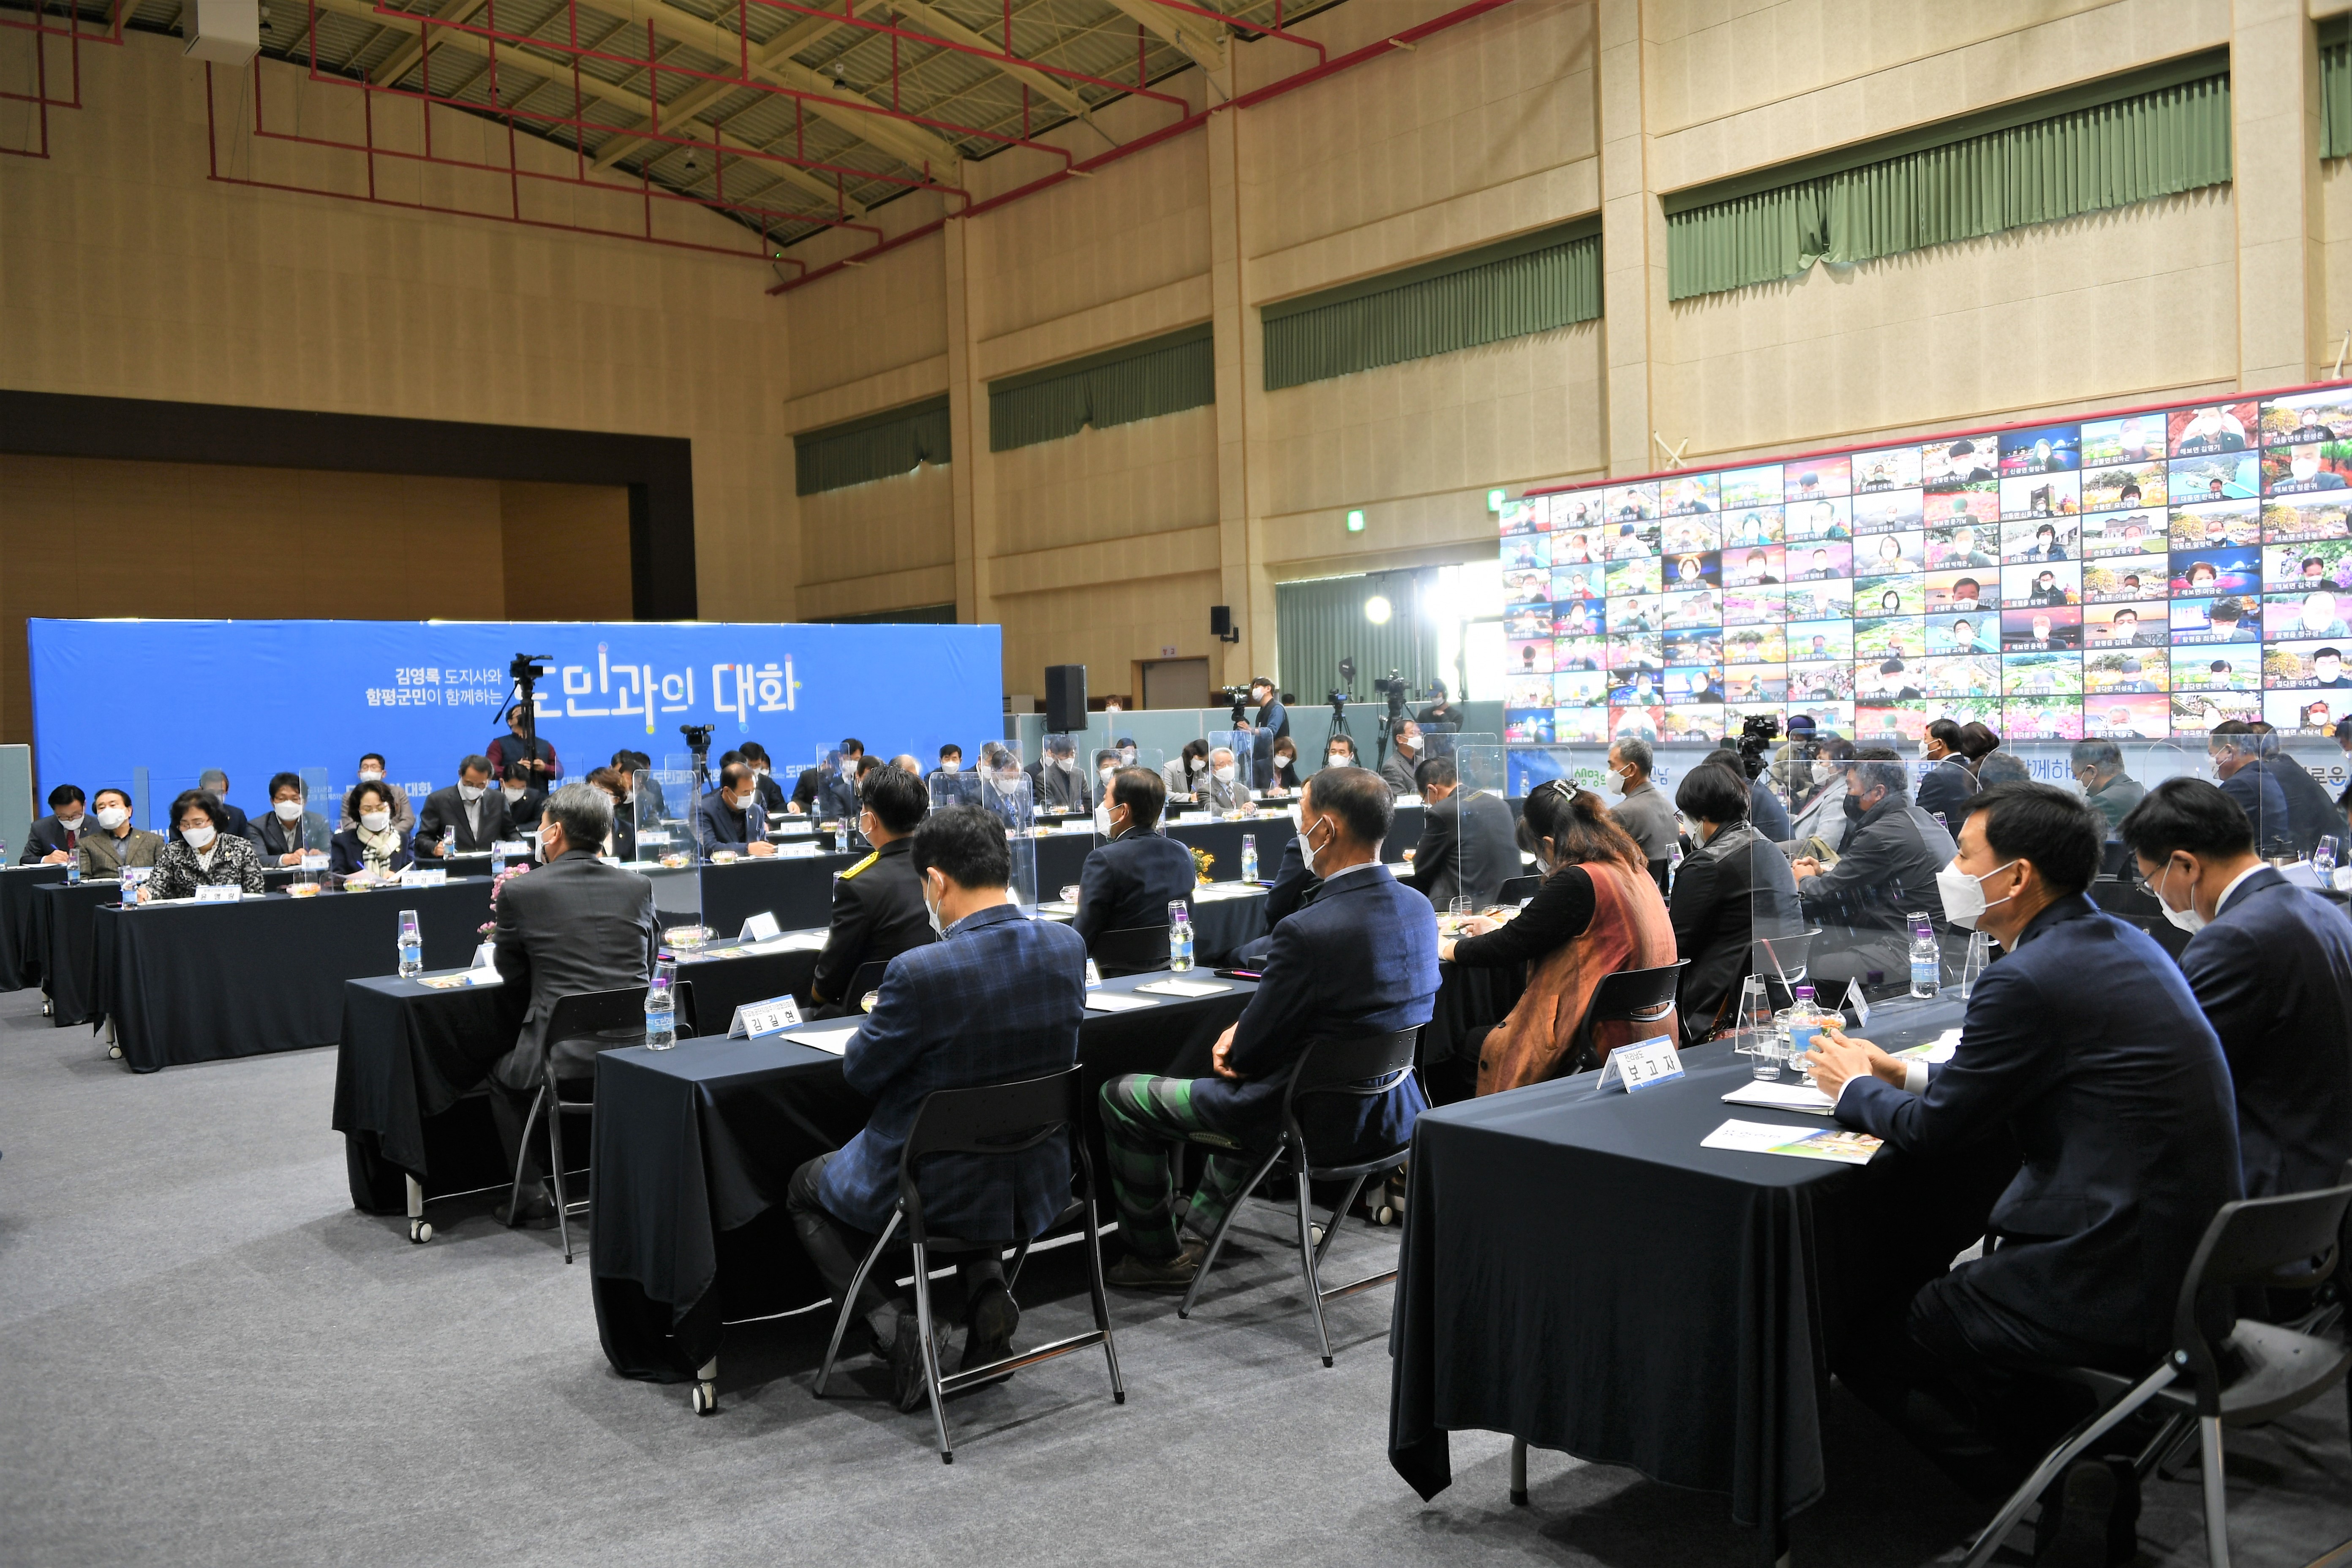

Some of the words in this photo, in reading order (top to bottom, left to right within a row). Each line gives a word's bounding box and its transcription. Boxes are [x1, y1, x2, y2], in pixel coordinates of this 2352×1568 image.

[2180, 446, 2199, 455] 해보면
[2274, 484, 2294, 493] 해보면
[2275, 533, 2295, 542] 해보면
[2181, 588, 2201, 596] 해보면
[2276, 582, 2295, 590] 해보면
[396, 667, 440, 685] 김영록
[444, 668, 502, 685] 도지사와
[366, 689, 441, 706] 함평군민이
[445, 689, 502, 706] 함께하는
[713, 655, 801, 733] 대화
[2304, 766, 2347, 786] 로운
[405, 781, 432, 797] 대화
[751, 1010, 795, 1032] 김길현
[1624, 1051, 1644, 1062] 전라남도
[1628, 1055, 1676, 1081] 보고자
